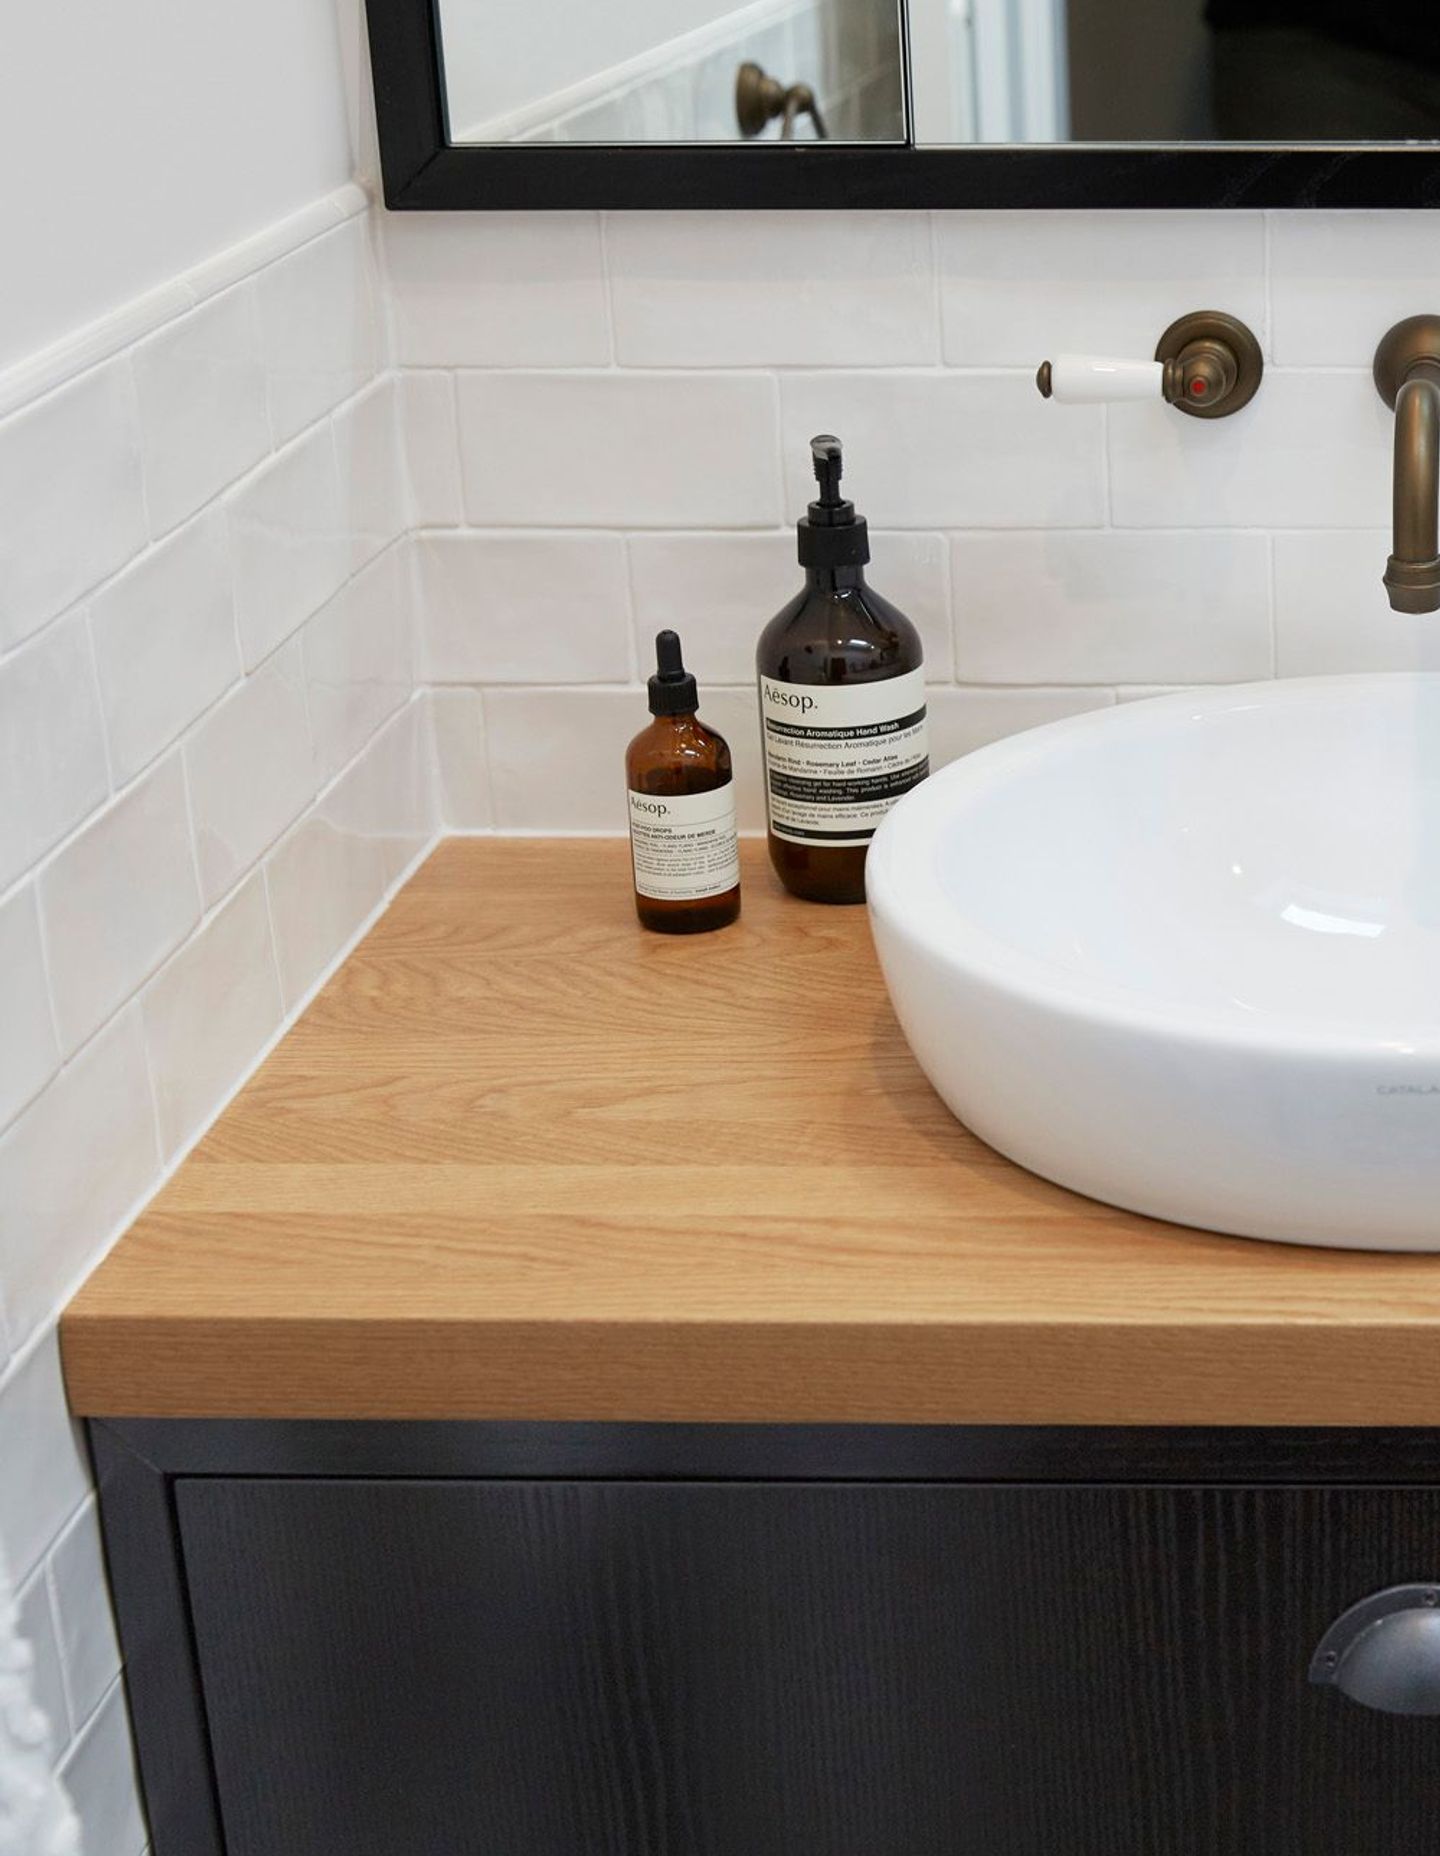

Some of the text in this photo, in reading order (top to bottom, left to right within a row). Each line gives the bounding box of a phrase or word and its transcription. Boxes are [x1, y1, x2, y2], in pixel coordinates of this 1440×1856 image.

[768, 721, 900, 738] urrection Aromatique Hand Wash
[806, 760, 840, 768] Rosemary
